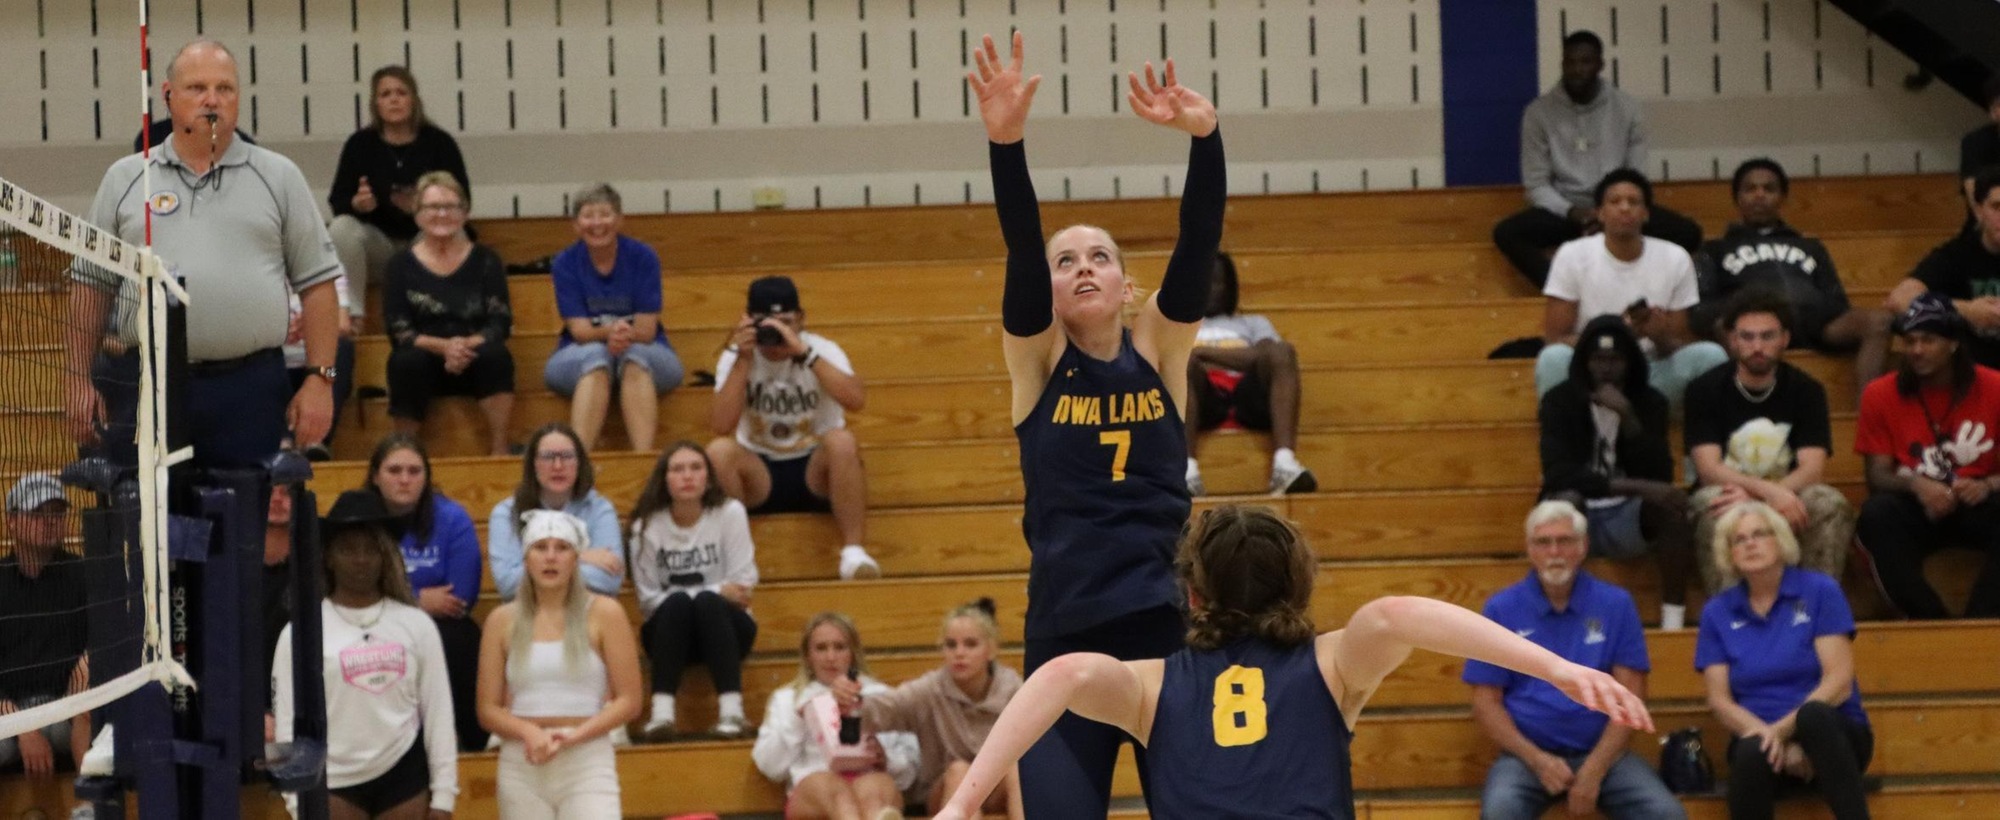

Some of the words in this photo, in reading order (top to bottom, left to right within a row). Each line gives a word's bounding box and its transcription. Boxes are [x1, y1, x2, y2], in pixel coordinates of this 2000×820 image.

[746, 381, 819, 415] Modelo
[1099, 430, 1131, 482] 7
[173, 586, 188, 642] sports
[1212, 664, 1267, 747] 8
